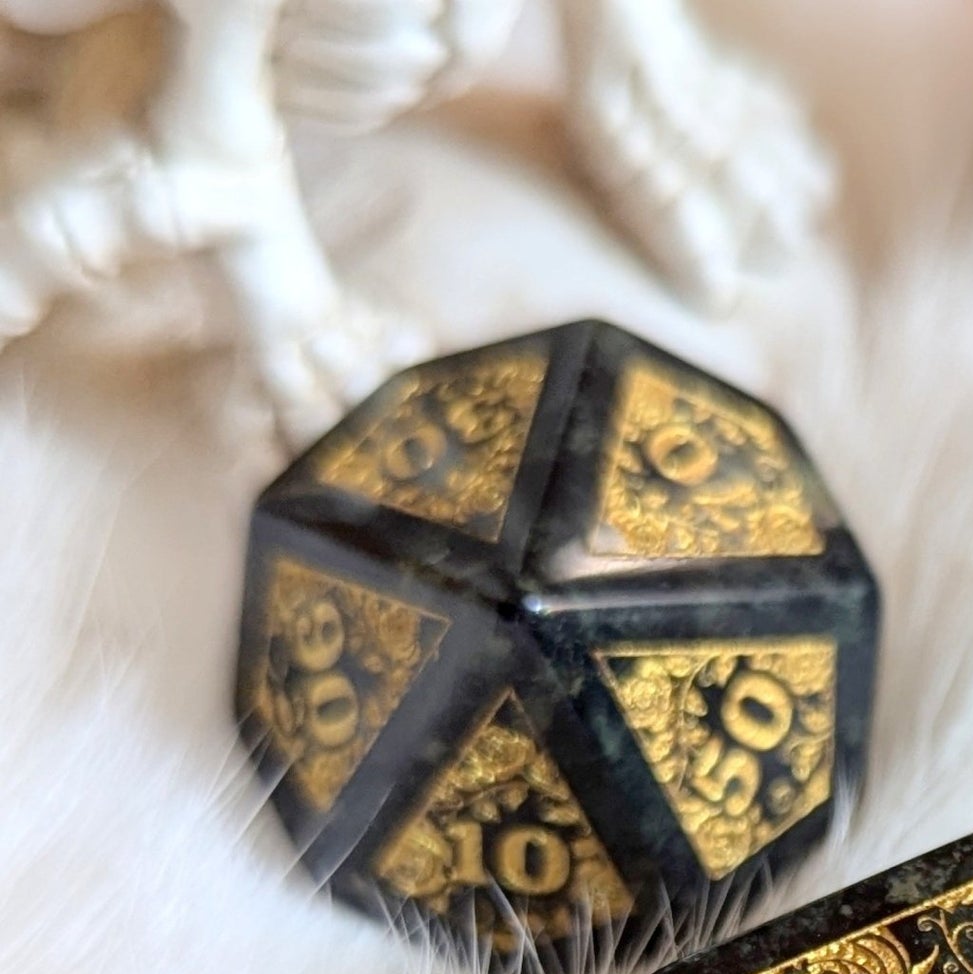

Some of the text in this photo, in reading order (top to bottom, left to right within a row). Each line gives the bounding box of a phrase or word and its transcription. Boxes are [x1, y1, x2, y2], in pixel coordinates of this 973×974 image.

[296, 600, 359, 746] 90
[690, 668, 793, 818] 50
[448, 822, 570, 896] 10
